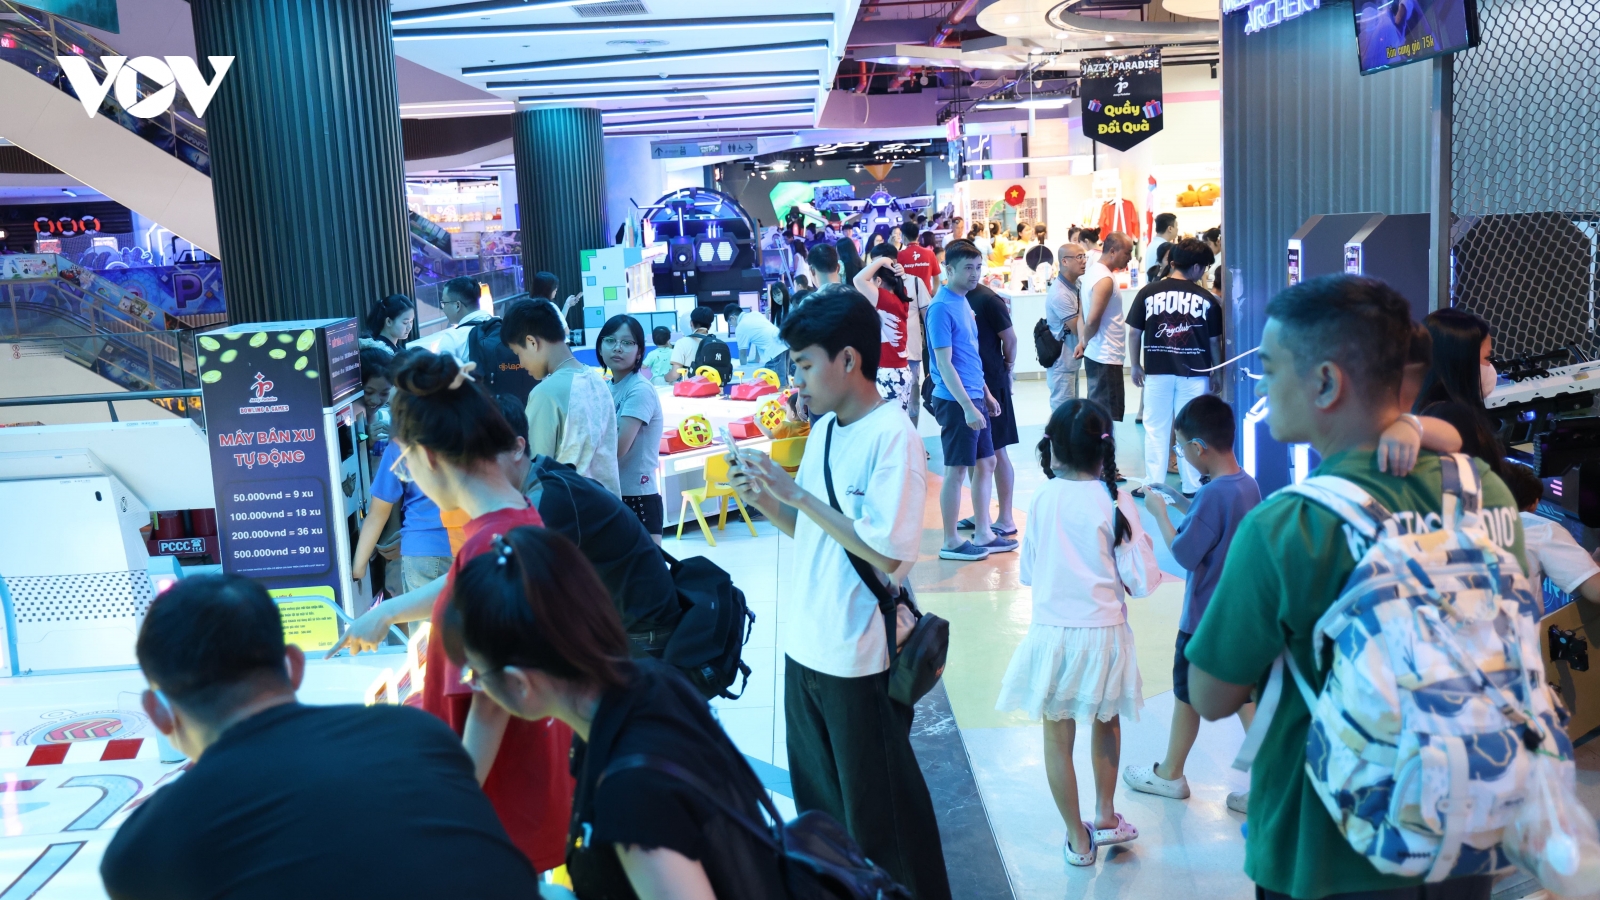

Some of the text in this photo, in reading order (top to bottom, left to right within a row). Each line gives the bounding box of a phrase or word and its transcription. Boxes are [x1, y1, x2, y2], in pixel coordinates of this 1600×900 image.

[1082, 59, 1159, 75] JAZZY PARADISE
[1104, 100, 1140, 117] Quầy
[1097, 119, 1150, 134] Đổi Quà
[239, 406, 264, 414] BOWLING
[270, 404, 289, 412] GAMES
[219, 427, 315, 446] MÁY BÁN XU
[234, 448, 305, 469] TỰ ĐỘNG
[233, 491, 283, 502] 50.000vnd
[293, 490, 299, 498] 9
[230, 509, 285, 521] 100.000vnd
[295, 508, 307, 517] 18
[231, 529, 287, 540] 200.000vnd
[297, 527, 309, 536] 36
[311, 527, 323, 535] xu
[161, 541, 191, 552] PCCC
[233, 547, 288, 559] 500.000vnd
[299, 546, 311, 554] 90
[313, 546, 325, 554] xu
